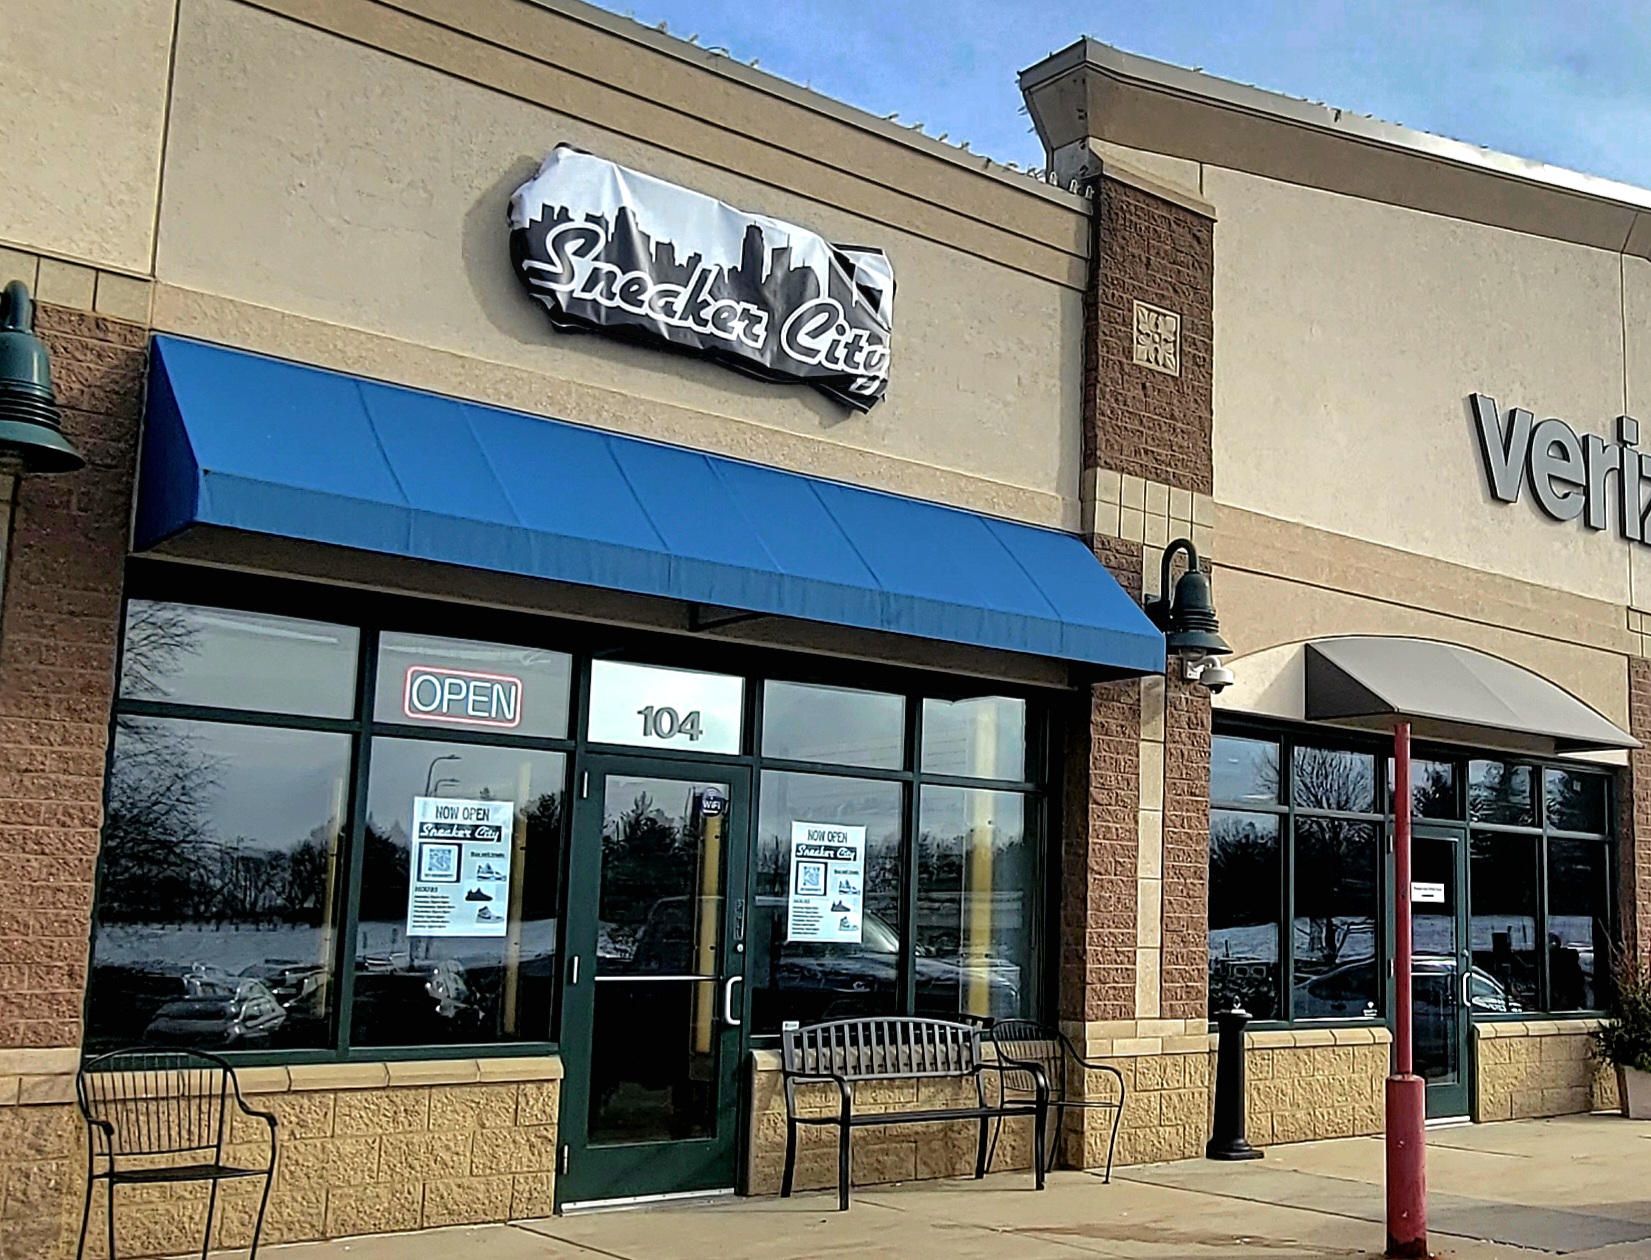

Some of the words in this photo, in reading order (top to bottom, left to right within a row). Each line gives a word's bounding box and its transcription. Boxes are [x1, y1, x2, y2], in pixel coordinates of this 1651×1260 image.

[523, 221, 770, 350] Sneaker
[780, 299, 891, 395] City
[1469, 392, 1651, 548] veri
[411, 674, 517, 720] OPEN
[636, 705, 703, 742] 104
[435, 805, 459, 820] NOW
[462, 806, 490, 821] OPEN
[420, 823, 471, 838] Sneaker
[475, 826, 500, 843] City
[808, 829, 826, 842] NOW
[827, 831, 848, 844] OPEN
[796, 845, 835, 858] Sneaker
[837, 847, 856, 861] City
